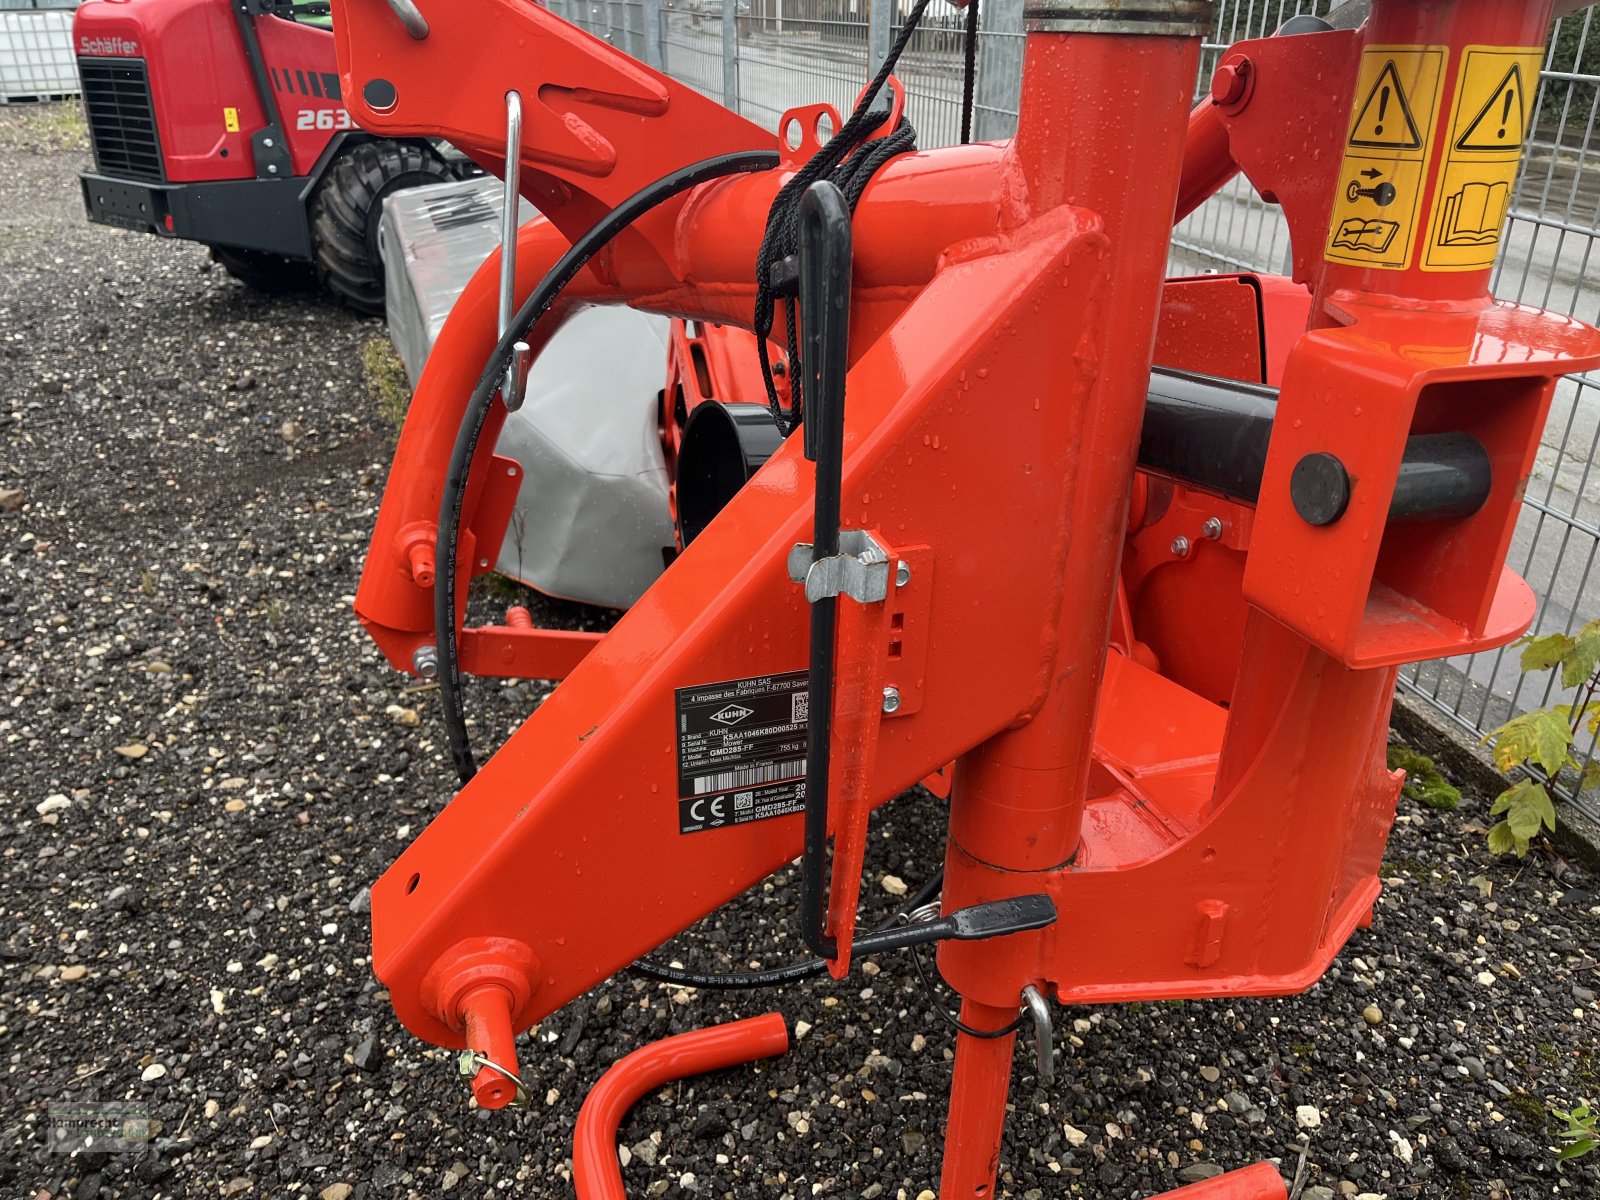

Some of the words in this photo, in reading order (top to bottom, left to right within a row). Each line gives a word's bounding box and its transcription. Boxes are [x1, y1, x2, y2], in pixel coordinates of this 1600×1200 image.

[79, 36, 138, 54] Schäffer
[296, 108, 361, 131] 263
[737, 680, 757, 689] KUHN
[757, 677, 772, 686] SAS
[690, 695, 696, 703] 4
[696, 693, 723, 702] Impasse
[723, 690, 735, 698] des
[736, 687, 766, 697] Fabriques
[766, 682, 791, 692] F-67700
[717, 709, 747, 720] KUHN
[709, 728, 729, 737] KUHN
[723, 724, 798, 741] KSAA1046K80D00525
[723, 740, 744, 748] Mower
[791, 743, 799, 752] kg
[709, 744, 754, 757] GMD285-FF
[755, 760, 774, 768] France
[795, 782, 806, 792] 20
[690, 795, 725, 821] CE
[755, 800, 797, 813] GMD285-FF
[759, 974, 780, 982] Poland
